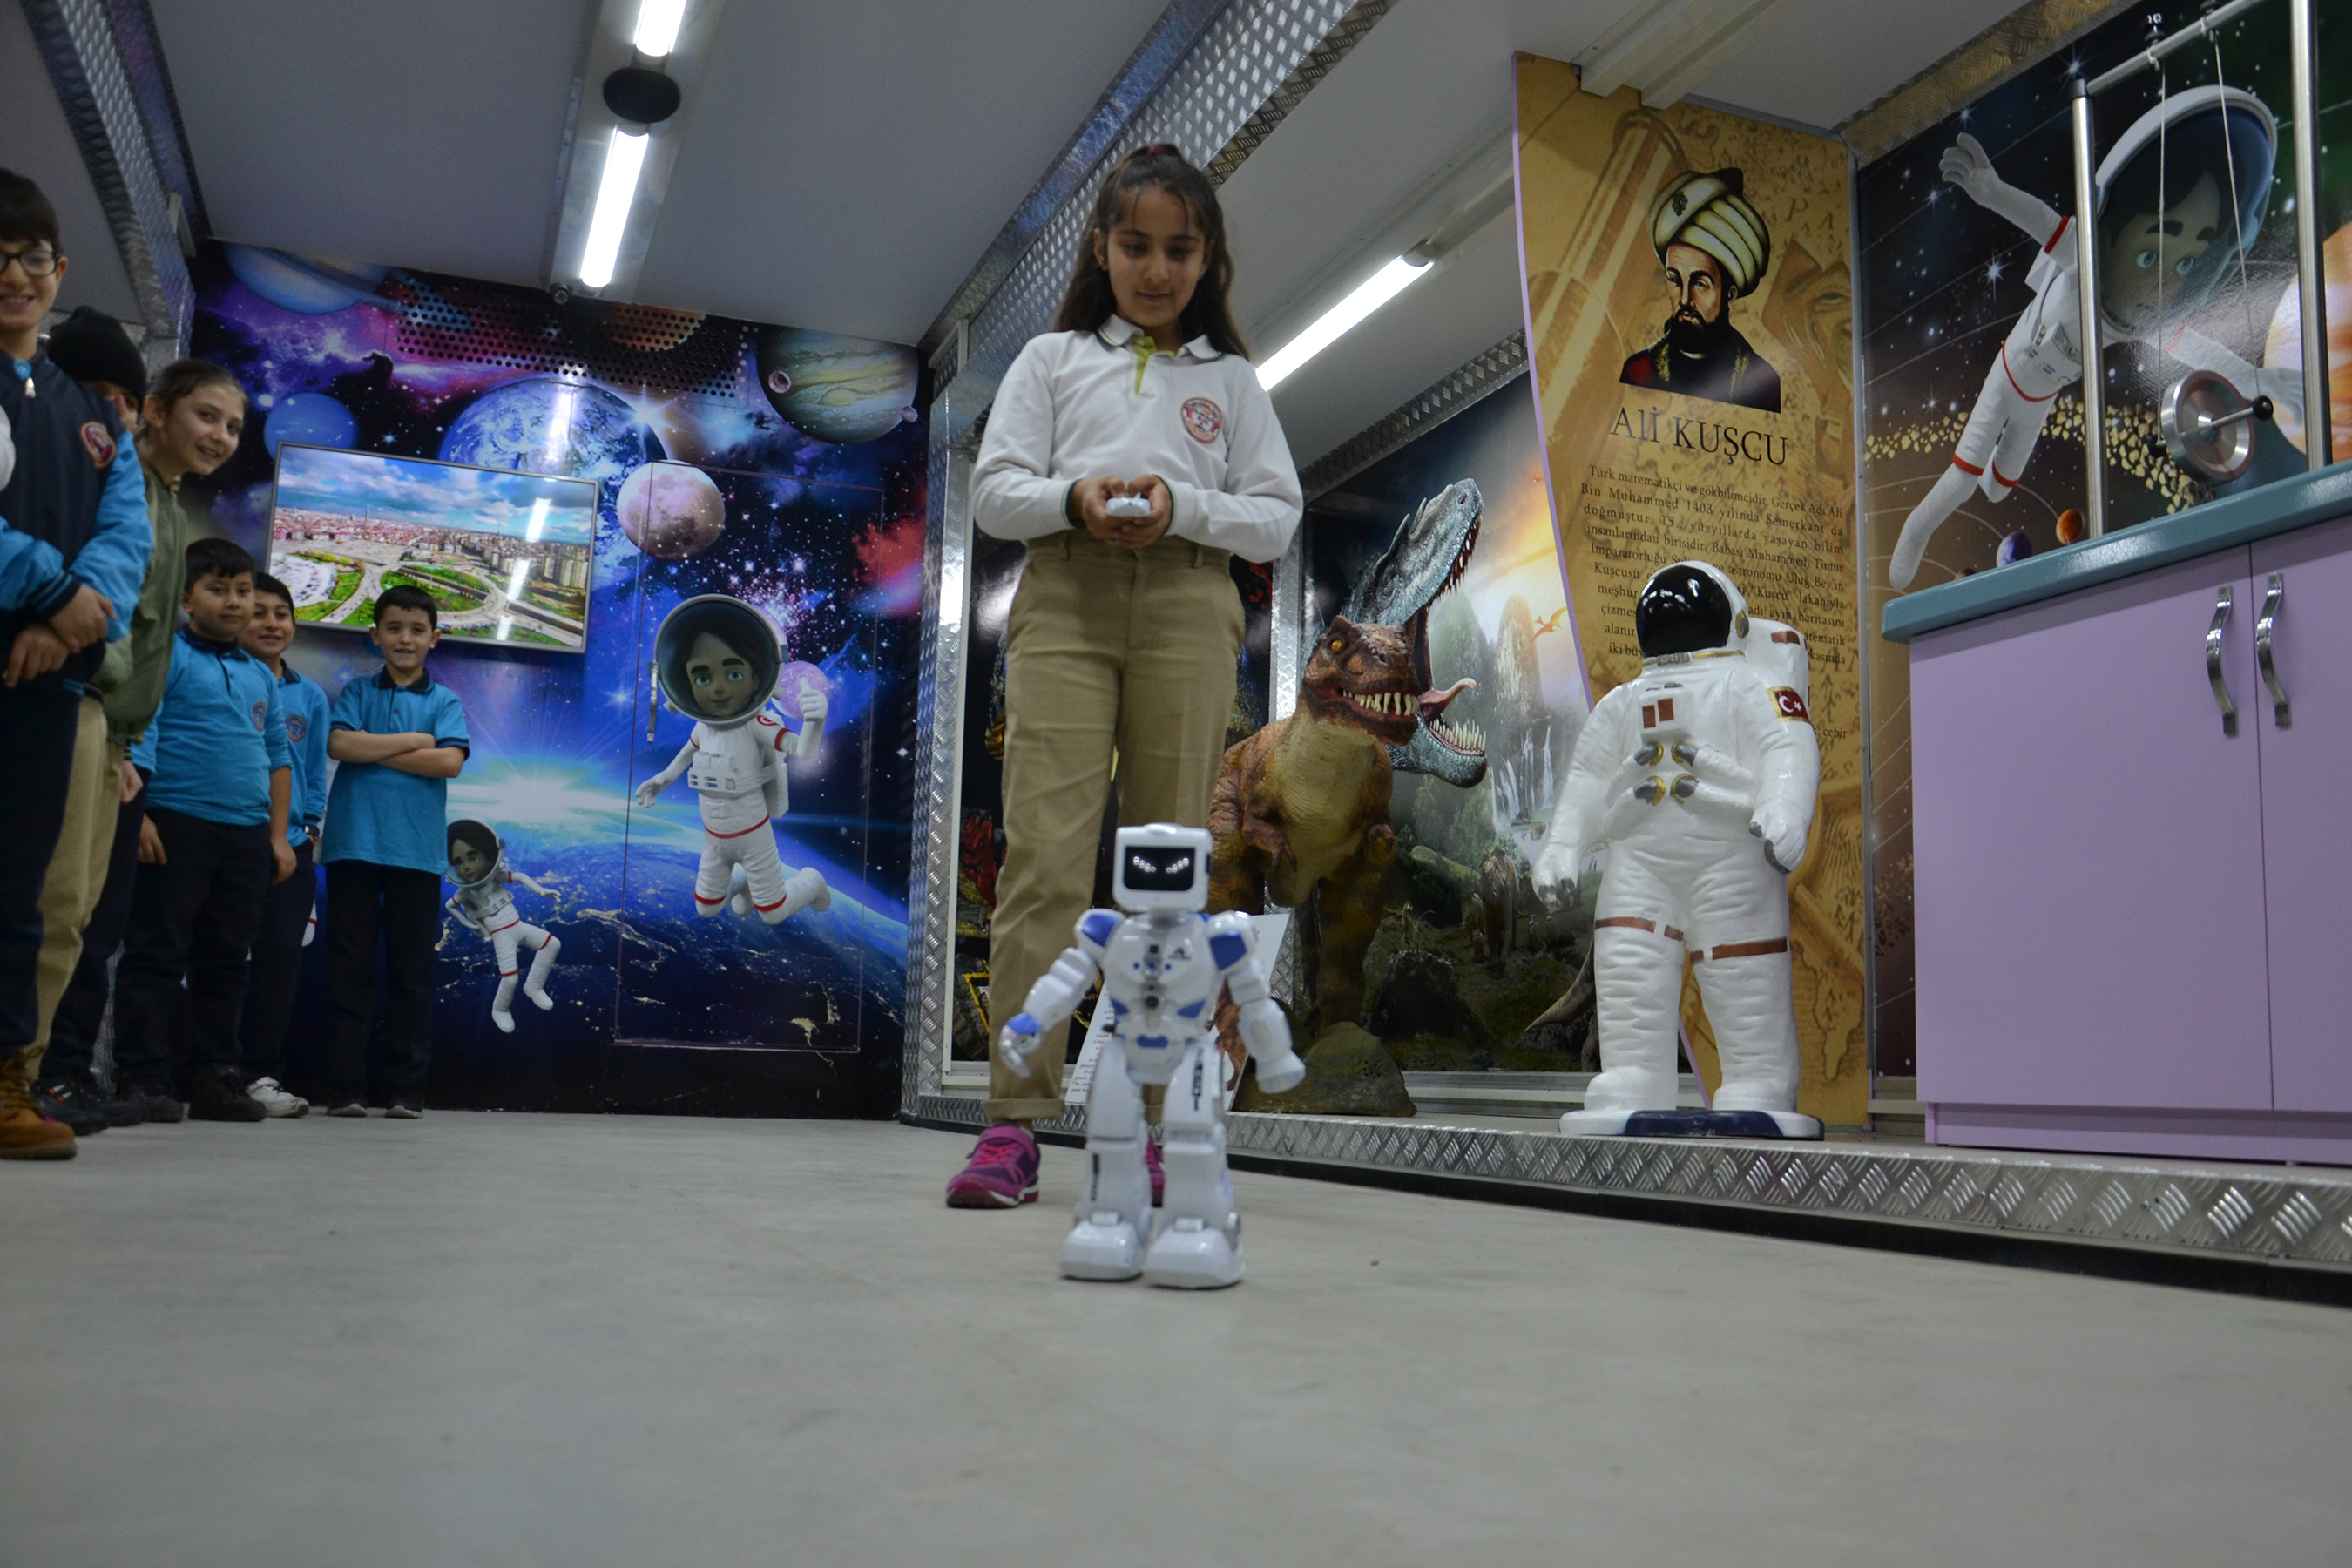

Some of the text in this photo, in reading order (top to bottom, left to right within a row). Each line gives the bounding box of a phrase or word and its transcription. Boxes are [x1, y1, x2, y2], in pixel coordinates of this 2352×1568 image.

[1673, 416, 1788, 465] KUŞCU
[1581, 483, 1843, 537] Bin Muhammed 1403 yılında Semerkant da
[1589, 464, 1615, 480] Türk
[1619, 471, 1682, 493] matematikçi
[1685, 483, 1697, 494] ve
[1772, 496, 1806, 512] Gerçek
[1808, 504, 1826, 516] Adı
[1828, 506, 1842, 518] Ali
[1583, 503, 1654, 524] doğmuştur.
[1690, 522, 1756, 541] yüzyıllarda
[1764, 533, 1808, 549] yaşayan
[1815, 540, 1843, 555] bilim
[1594, 562, 1640, 579] Kuşcusu
[1664, 534, 1707, 551] birisidir.
[1713, 542, 1744, 558] Babası
[1814, 558, 1843, 572] Timur
[1728, 566, 1781, 582] astronomu
[1786, 571, 1810, 588] Uluğ
[1598, 584, 1638, 598] meşhur
[1770, 609, 1791, 621] ayın
[1798, 611, 1845, 627] haritasını
[1601, 602, 1845, 645] çizmes atematik
[1609, 643, 1643, 660] iki büy
[1808, 648, 1846, 665] kasında
[1822, 727, 1847, 739] cebir
